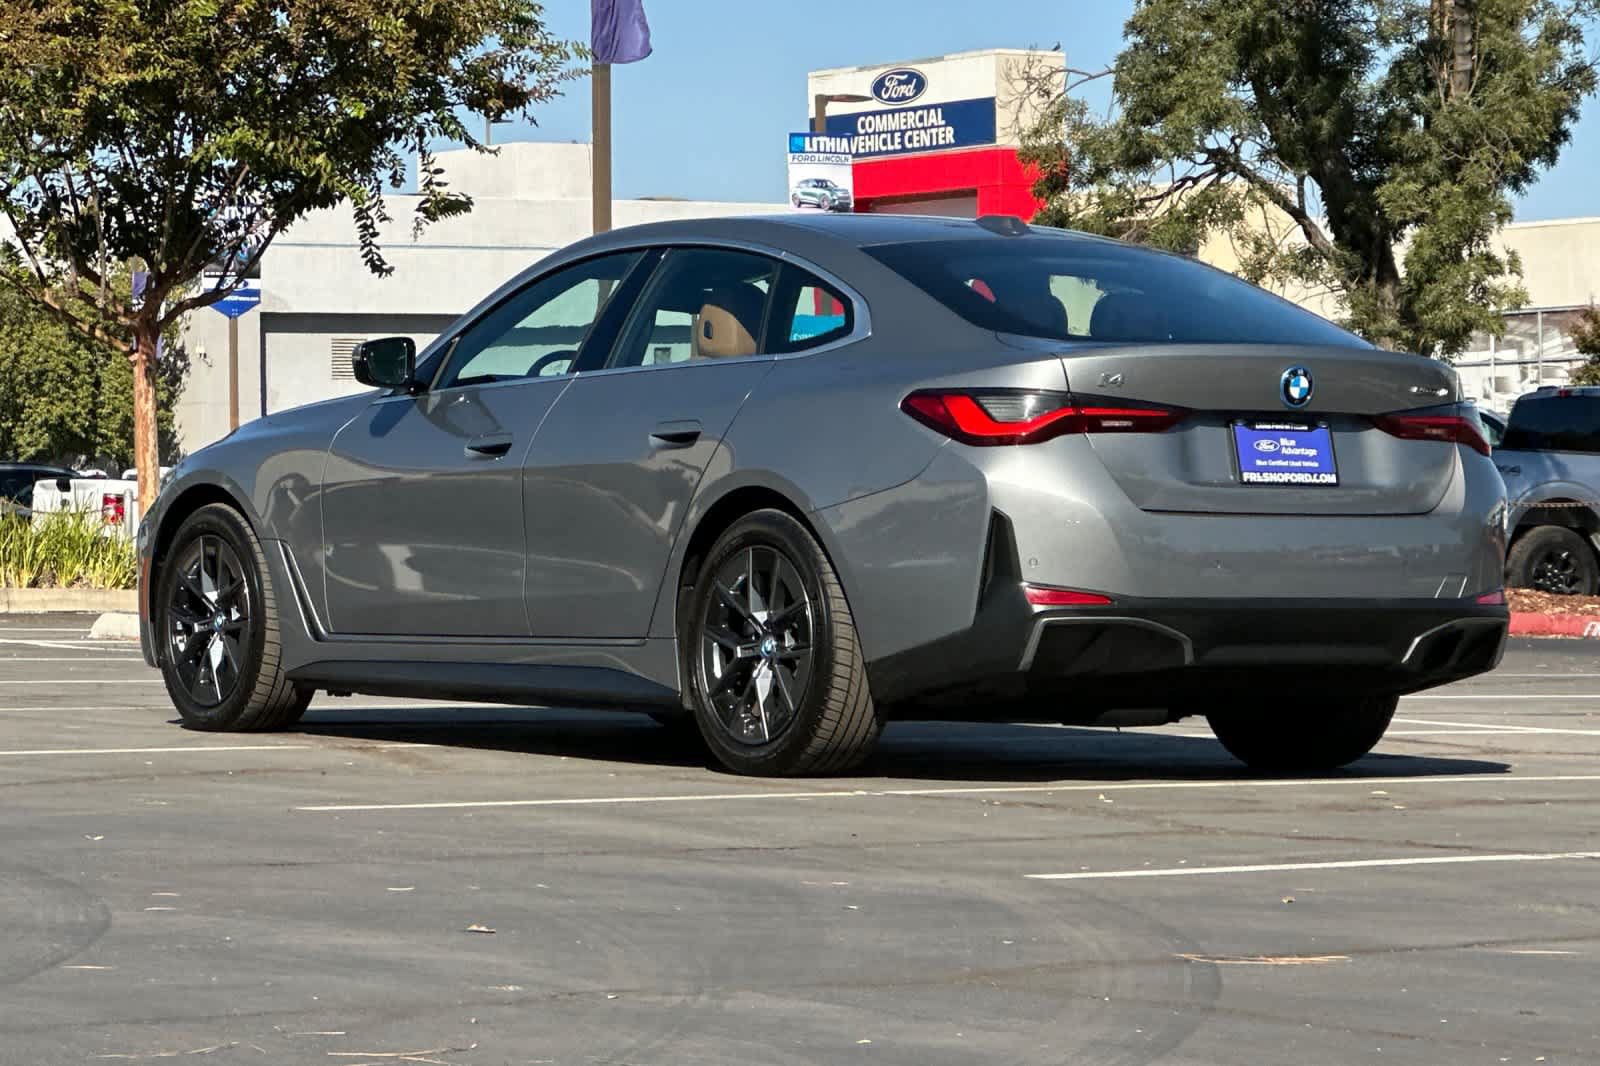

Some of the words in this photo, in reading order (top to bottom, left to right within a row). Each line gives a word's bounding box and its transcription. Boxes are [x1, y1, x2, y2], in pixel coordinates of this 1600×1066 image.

[881, 74, 918, 100] Ford
[857, 108, 946, 135] COMMERCIAL
[804, 136, 850, 153] LITHIA
[850, 132, 902, 154] VEHICLE
[904, 126, 955, 149] CENTER
[791, 154, 816, 162] FORD
[817, 155, 850, 163] LINCOLN
[1279, 438, 1296, 447] Blue
[1281, 447, 1318, 457] Advantage
